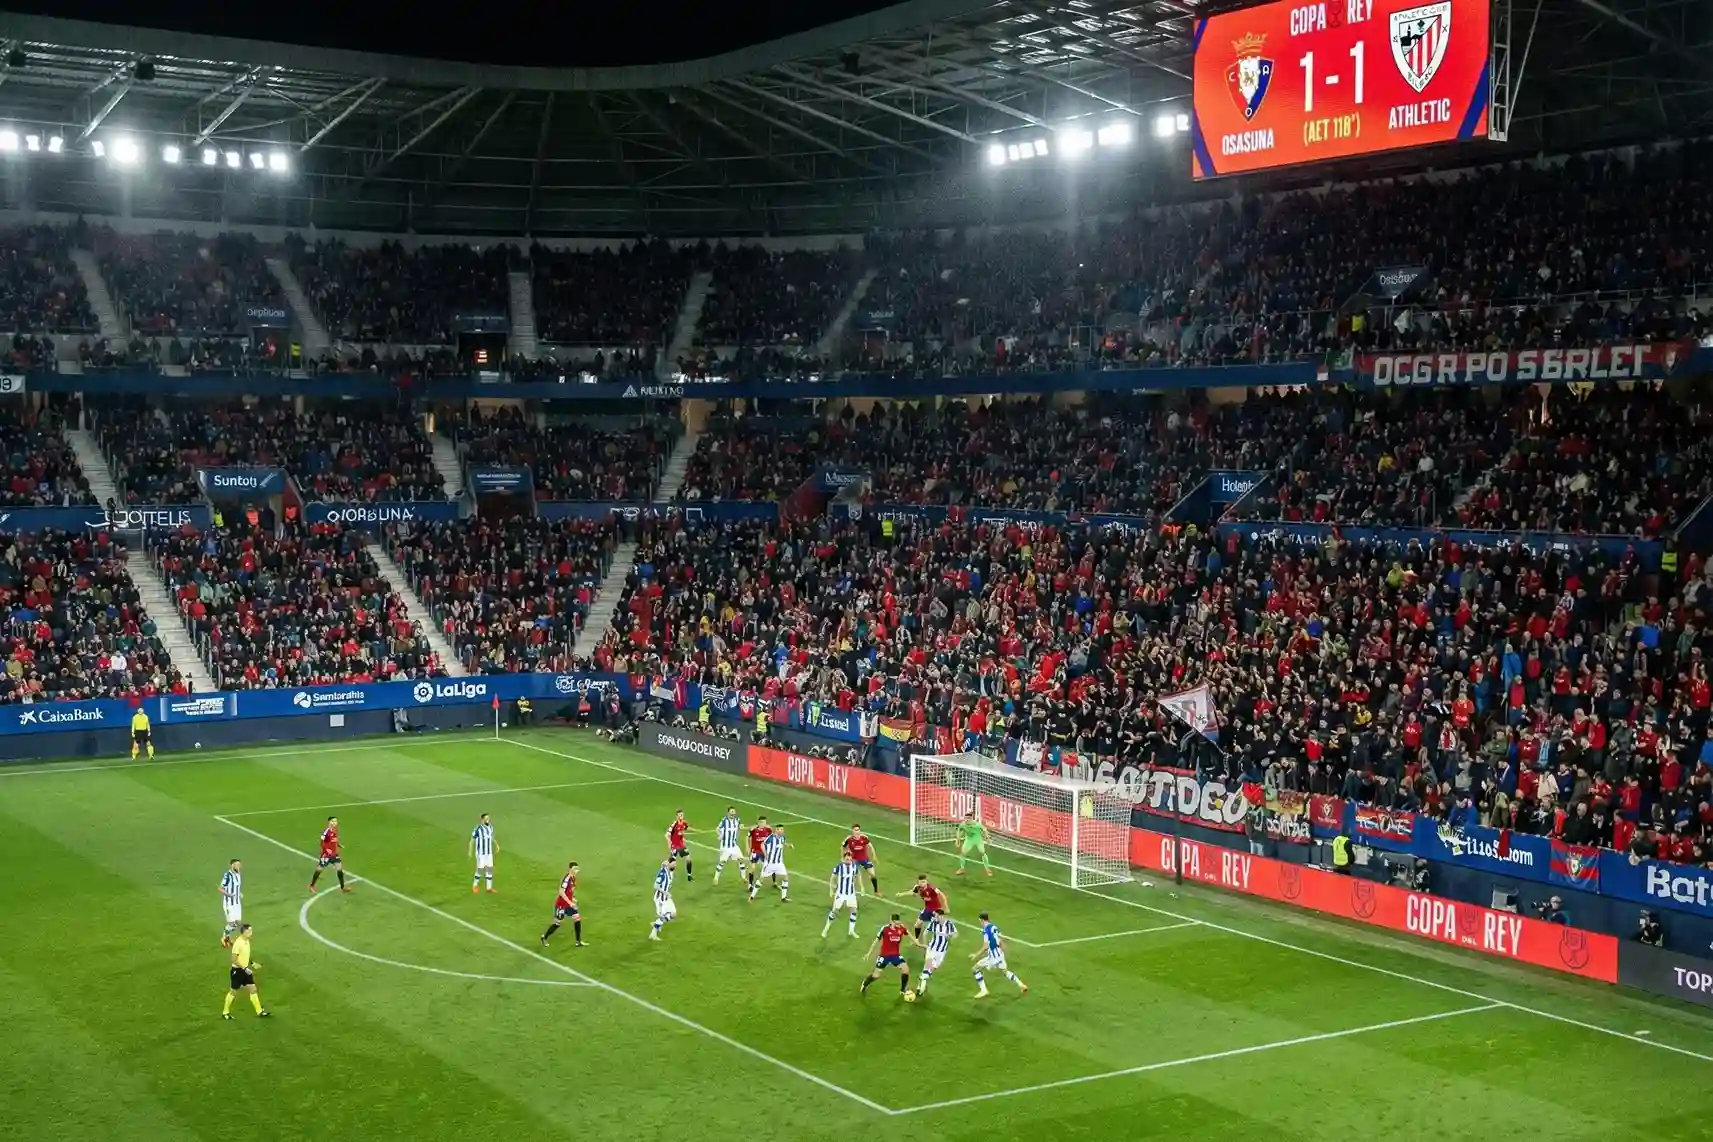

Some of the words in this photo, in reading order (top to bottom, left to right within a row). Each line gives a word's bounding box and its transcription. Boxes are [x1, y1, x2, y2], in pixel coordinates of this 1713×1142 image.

[1290, 3, 1327, 36] COPA
[1347, 0, 1373, 24] REY
[1300, 51, 1314, 112] 1
[1349, 40, 1364, 104] 1
[1388, 98, 1450, 130] ATHLETIC
[1221, 128, 1275, 156] OSASUNA
[1304, 118, 1330, 147] (AET
[436, 681, 487, 699] LaLiga
[38, 707, 104, 723] CaixaBank
[788, 756, 814, 785] COPA
[828, 764, 849, 794] REY
[999, 800, 1023, 833] REY
[1222, 851, 1251, 889] REY
[1406, 894, 1456, 940] COPA
[1484, 912, 1522, 956] REY
